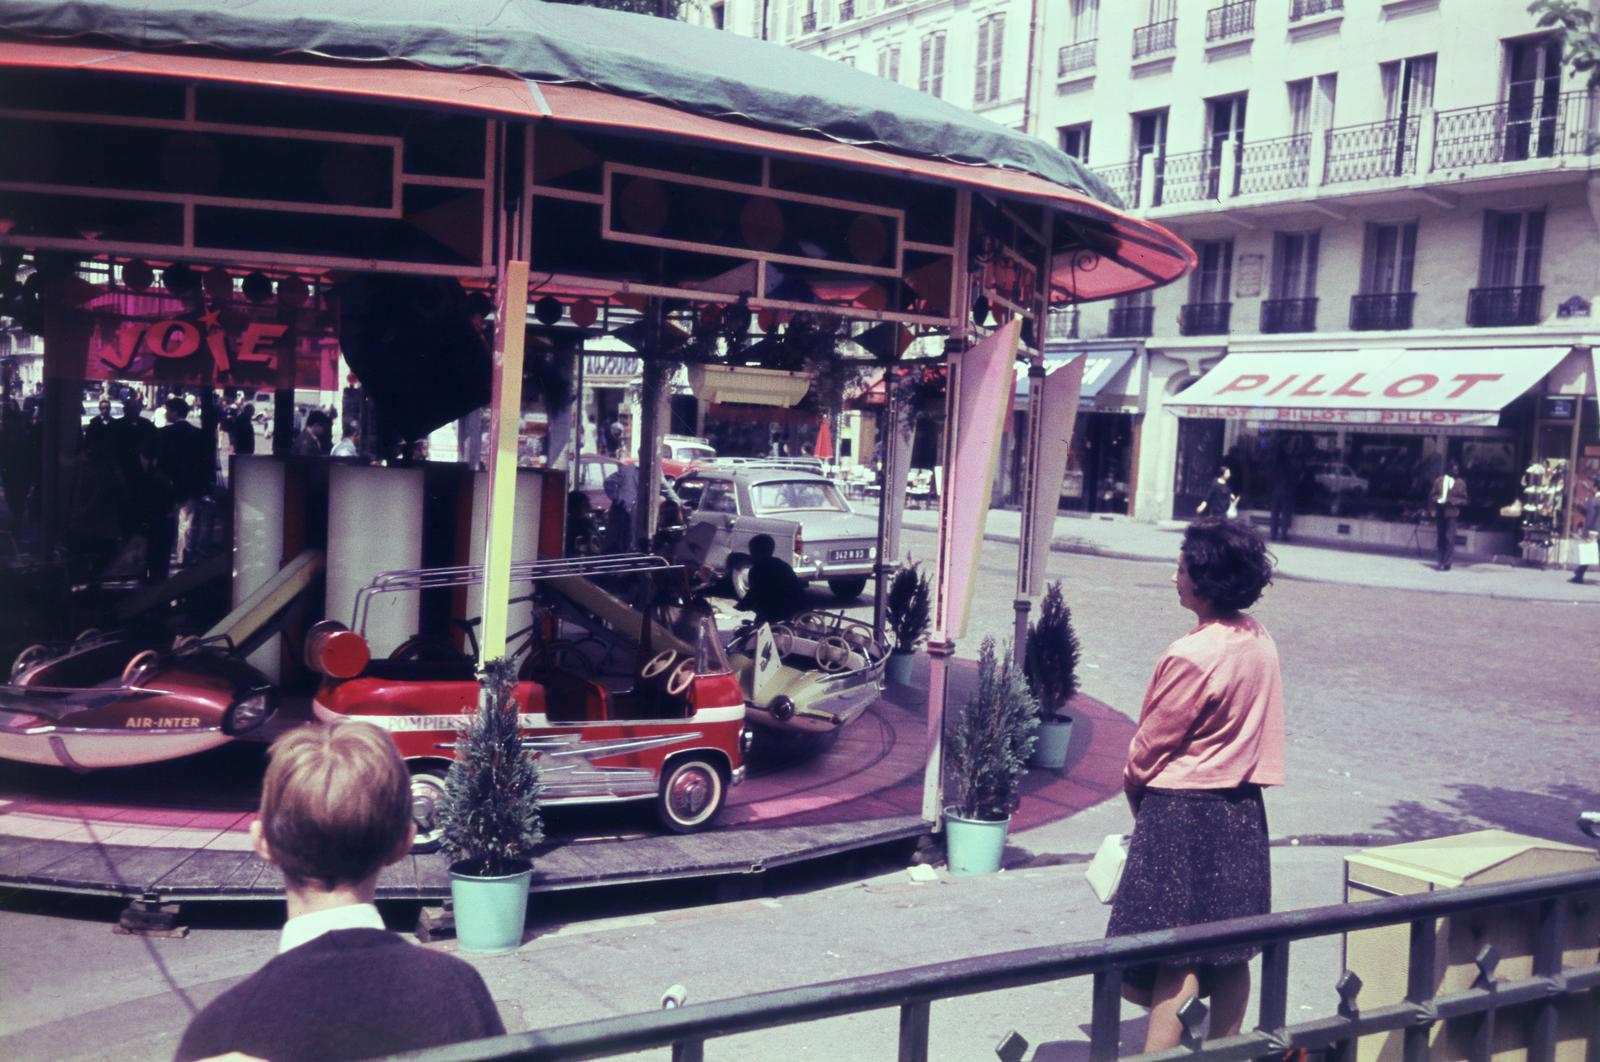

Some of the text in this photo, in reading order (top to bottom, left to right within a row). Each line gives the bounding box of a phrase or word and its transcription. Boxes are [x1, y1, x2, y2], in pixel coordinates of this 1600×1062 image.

[1214, 373, 1505, 399] PILLOT
[1187, 406, 1462, 423] PILLOT PILLOT PILLOT
[126, 717, 200, 728] AIR-INTER
